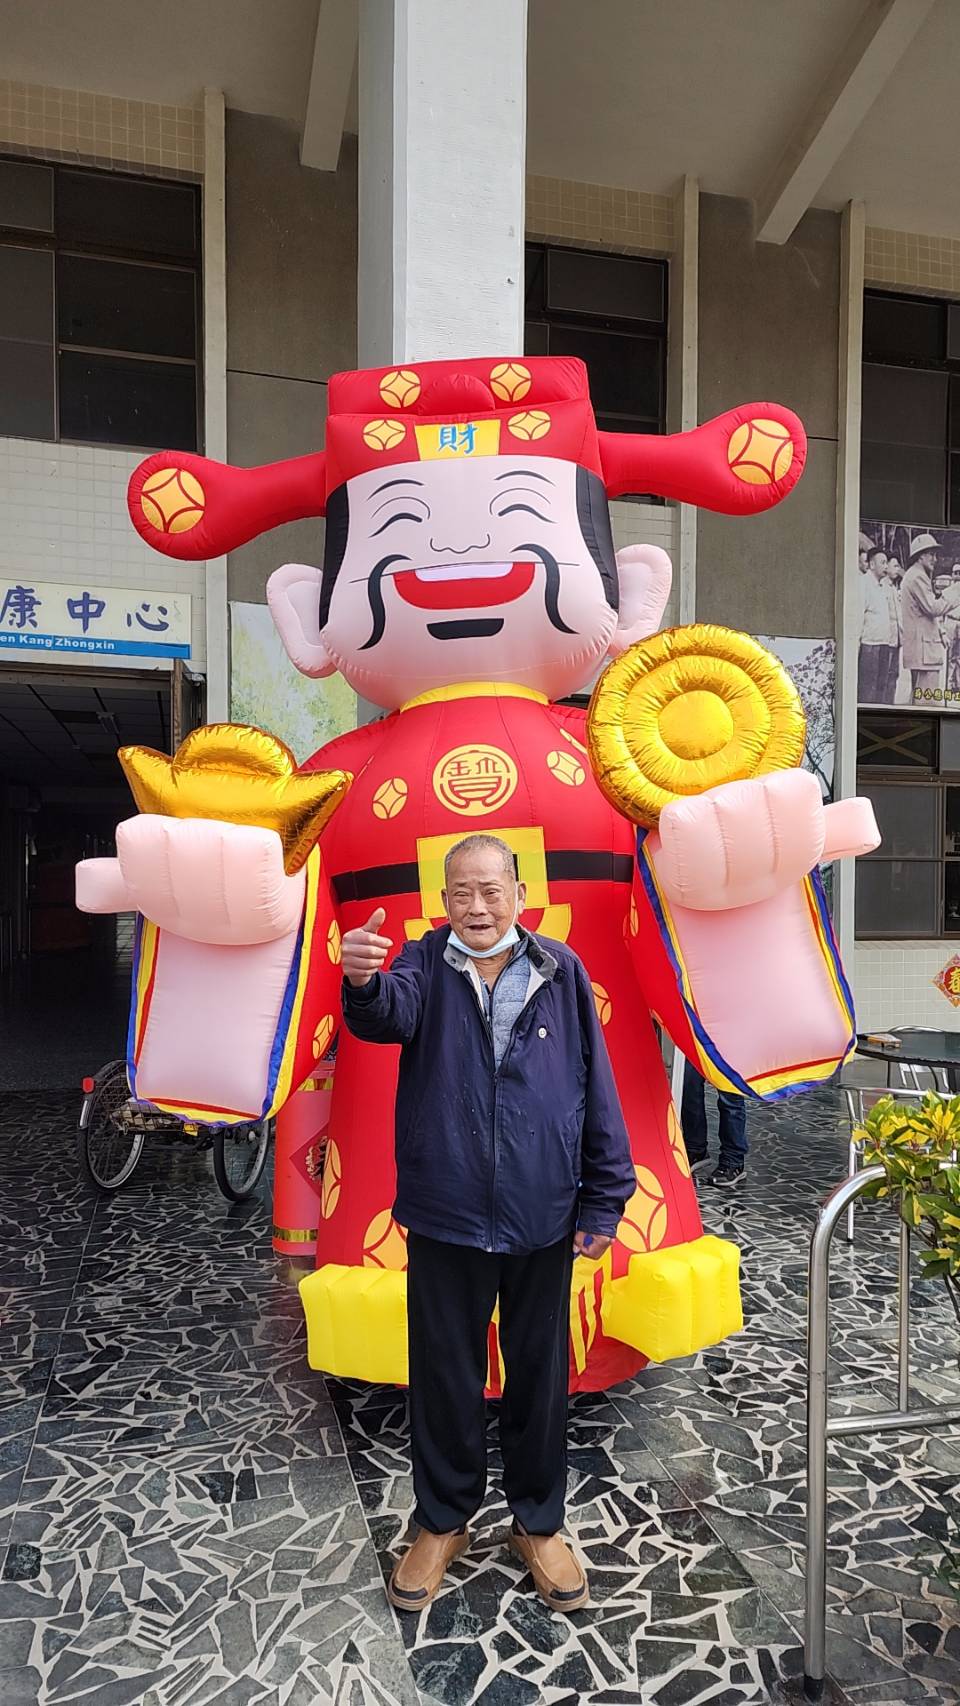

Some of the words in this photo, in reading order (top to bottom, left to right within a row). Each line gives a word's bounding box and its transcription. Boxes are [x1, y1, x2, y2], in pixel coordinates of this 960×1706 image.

[438, 423, 477, 454] 財
[0, 585, 169, 633] 康中心
[19, 634, 52, 648] Kang
[54, 638, 115, 650] Zhongxin
